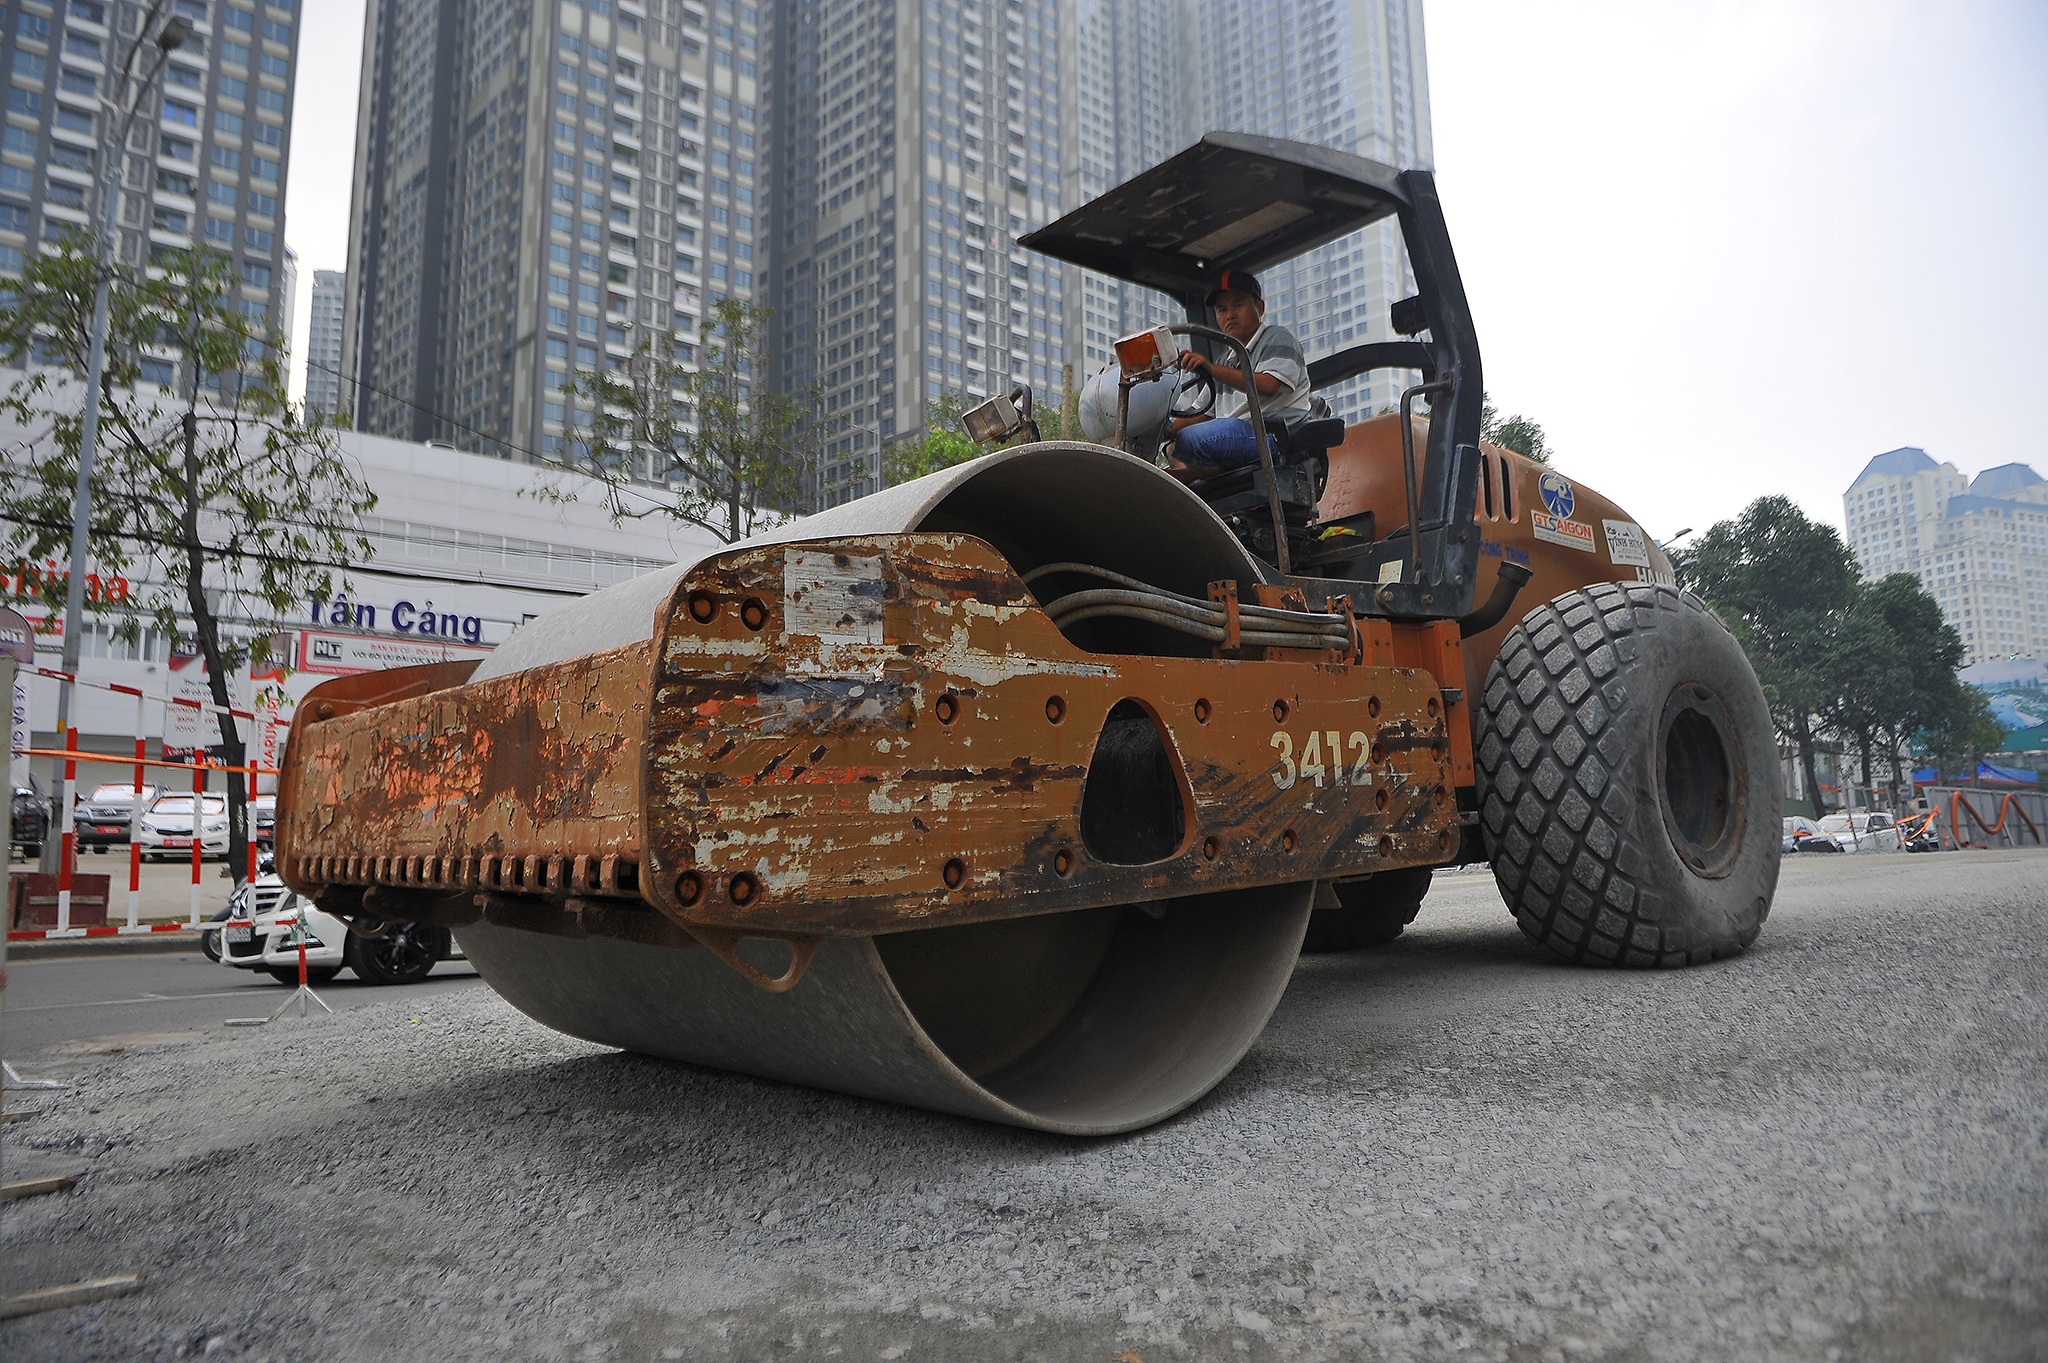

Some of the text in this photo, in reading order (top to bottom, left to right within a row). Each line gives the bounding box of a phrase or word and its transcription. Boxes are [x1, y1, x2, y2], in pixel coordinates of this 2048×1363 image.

[311, 589, 482, 645] Tân Cảng
[314, 640, 341, 658] NT
[1270, 730, 1373, 790] 3412
